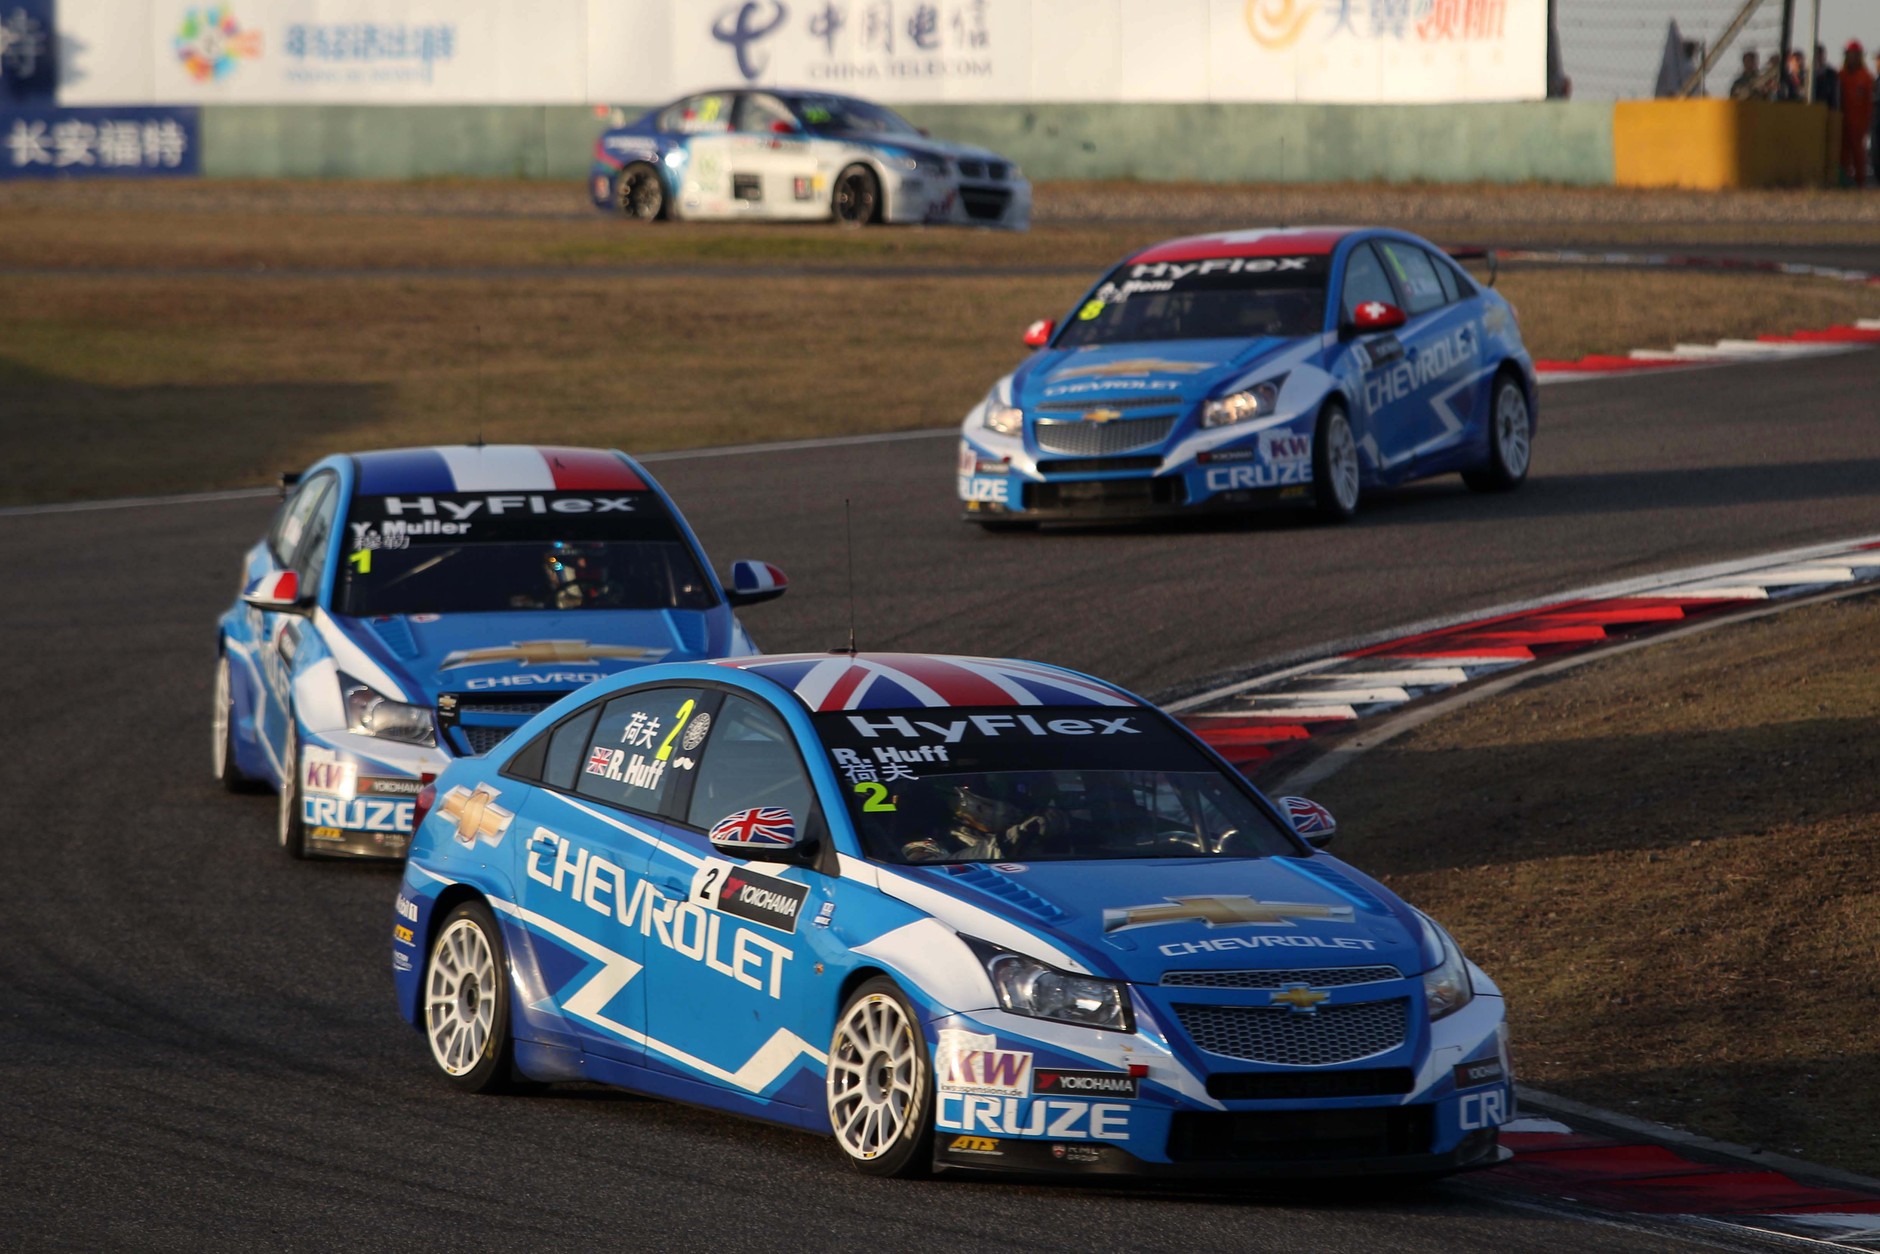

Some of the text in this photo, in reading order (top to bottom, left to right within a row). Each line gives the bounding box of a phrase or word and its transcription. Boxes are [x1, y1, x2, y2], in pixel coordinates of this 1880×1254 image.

[809, 0, 989, 53] 中国电信
[809, 58, 993, 79] CHINA TELECOM
[6, 118, 188, 168] 长安福特
[1132, 257, 1309, 281] HyFlex
[1364, 321, 1478, 416] CHEVROLET
[1044, 380, 1182, 397] CHEVROLET
[1269, 435, 1308, 459] KW
[1206, 462, 1313, 491] CRUZE
[384, 495, 636, 520] HyFlex
[351, 519, 473, 537] Y. Muller
[349, 549, 371, 574] 1
[466, 672, 607, 690] CHEVRO
[621, 712, 661, 750] 荷夫
[655, 699, 695, 761] 2
[847, 714, 1143, 743] HyFlex
[605, 749, 667, 790] R. Huff
[831, 746, 950, 764] R. Huff
[840, 762, 919, 784] 荷夫
[854, 782, 897, 813] 2
[303, 796, 417, 832] CRUZE
[700, 867, 719, 900] 2
[526, 826, 794, 999] CHEVROLET
[739, 884, 798, 917] YOKOHAMA
[1158, 935, 1376, 957] CHEVROLET
[948, 1050, 1030, 1088] KW
[1059, 1075, 1134, 1092] YOKOHAMA
[935, 1091, 1131, 1140] CRUZE
[951, 1135, 1000, 1151] ATS
